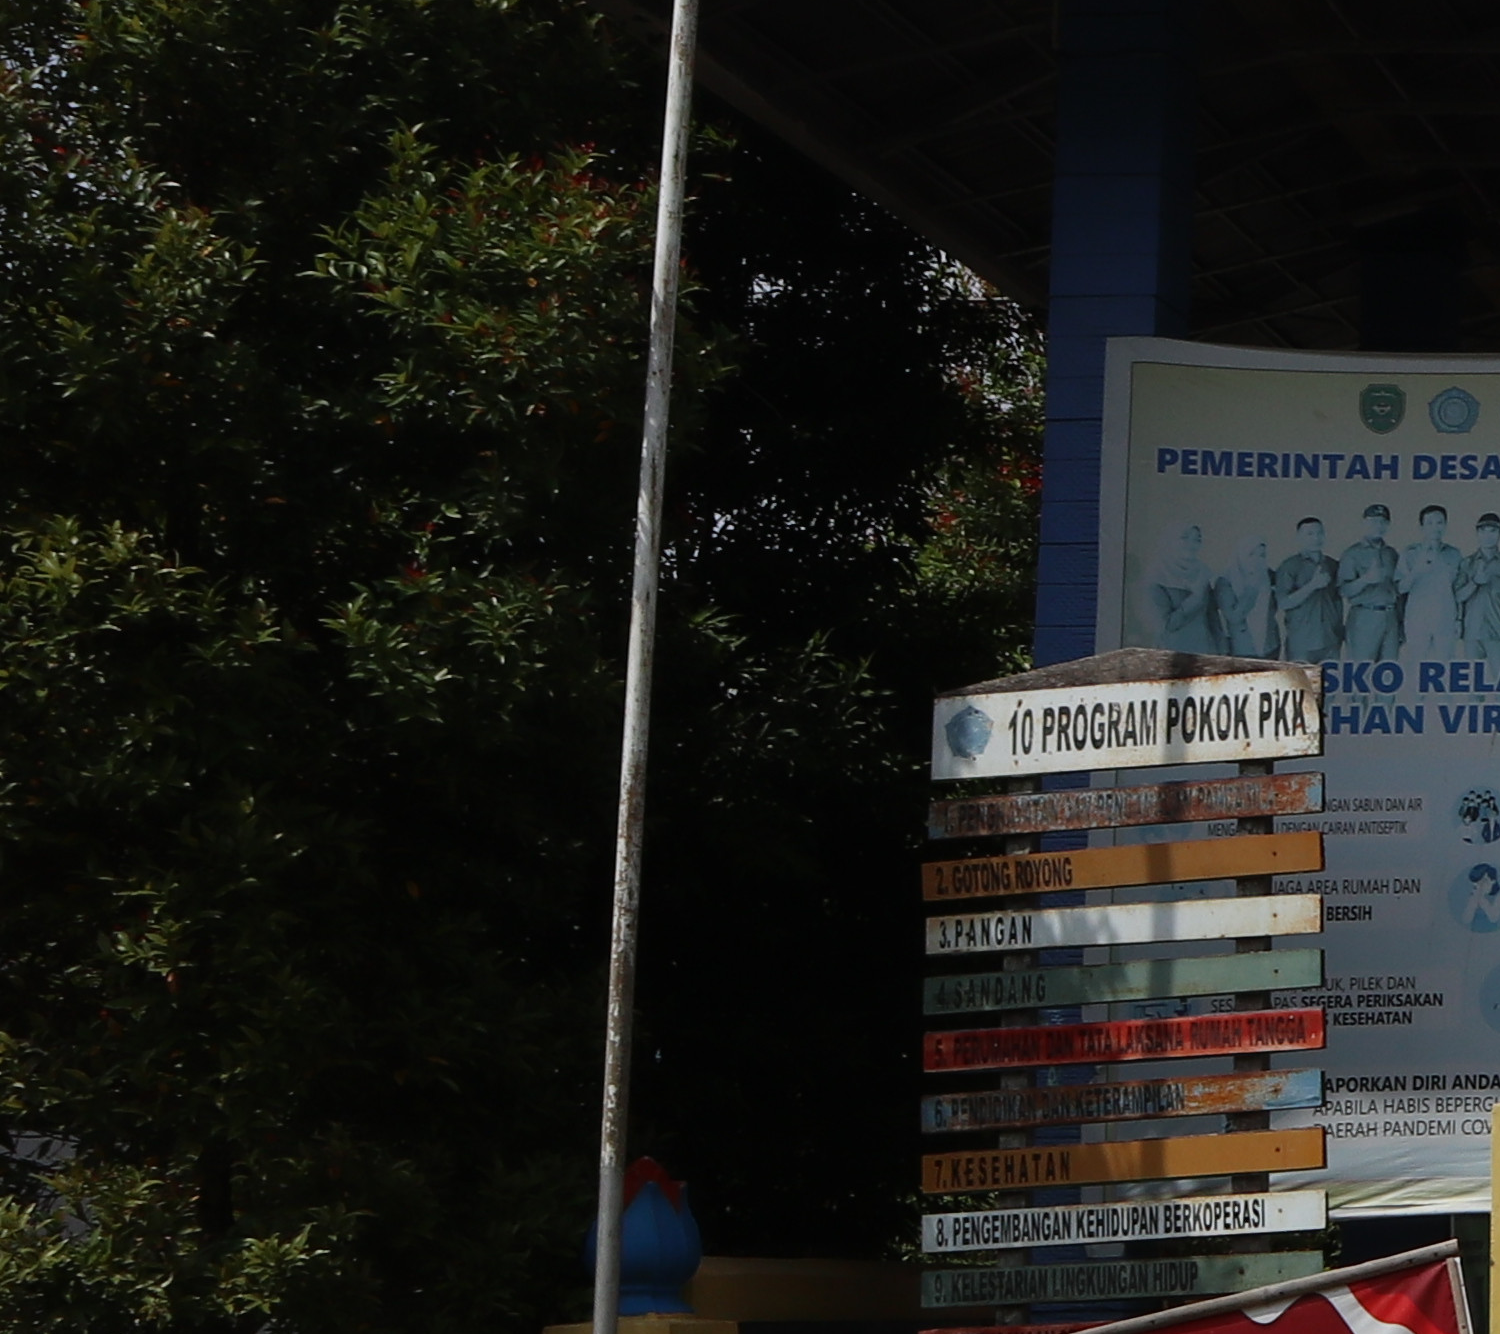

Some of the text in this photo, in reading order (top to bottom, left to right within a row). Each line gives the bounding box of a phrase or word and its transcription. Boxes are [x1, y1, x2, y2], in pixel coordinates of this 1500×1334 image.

[1157, 447, 1399, 482] PEMERINTAH
[1323, 662, 1404, 694] SKO
[1008, 705, 1034, 756] 10
[1041, 699, 1158, 754] PROGRAM
[1166, 693, 1251, 746] POKOK
[953, 857, 1073, 895] GOTONG ROYONG
[1306, 878, 1421, 894] AREA RUMAH DAN
[1326, 906, 1372, 921] BERSIH
[1350, 976, 1416, 990] PILEK DAN
[1300, 992, 1444, 1009] SEGERA PERIKSAKAN
[1333, 1011, 1413, 1026] KESEHATAN
[1117, 1015, 1307, 1054] LAKSANA RUMAH TANGGA
[1325, 1075, 1406, 1093] APORKAN
[1413, 1074, 1446, 1091] DIRI
[1313, 1099, 1378, 1117] APABILA
[1383, 1097, 1430, 1114] HABIS
[1383, 1120, 1456, 1138] PANDEMI
[936, 1198, 1266, 1247] 8. PENGEMBANGAN KEHIDUPAN BERKOPERASI
[951, 1261, 1199, 1301] KELESTARIAN LINGKUNGAN HIDUP
